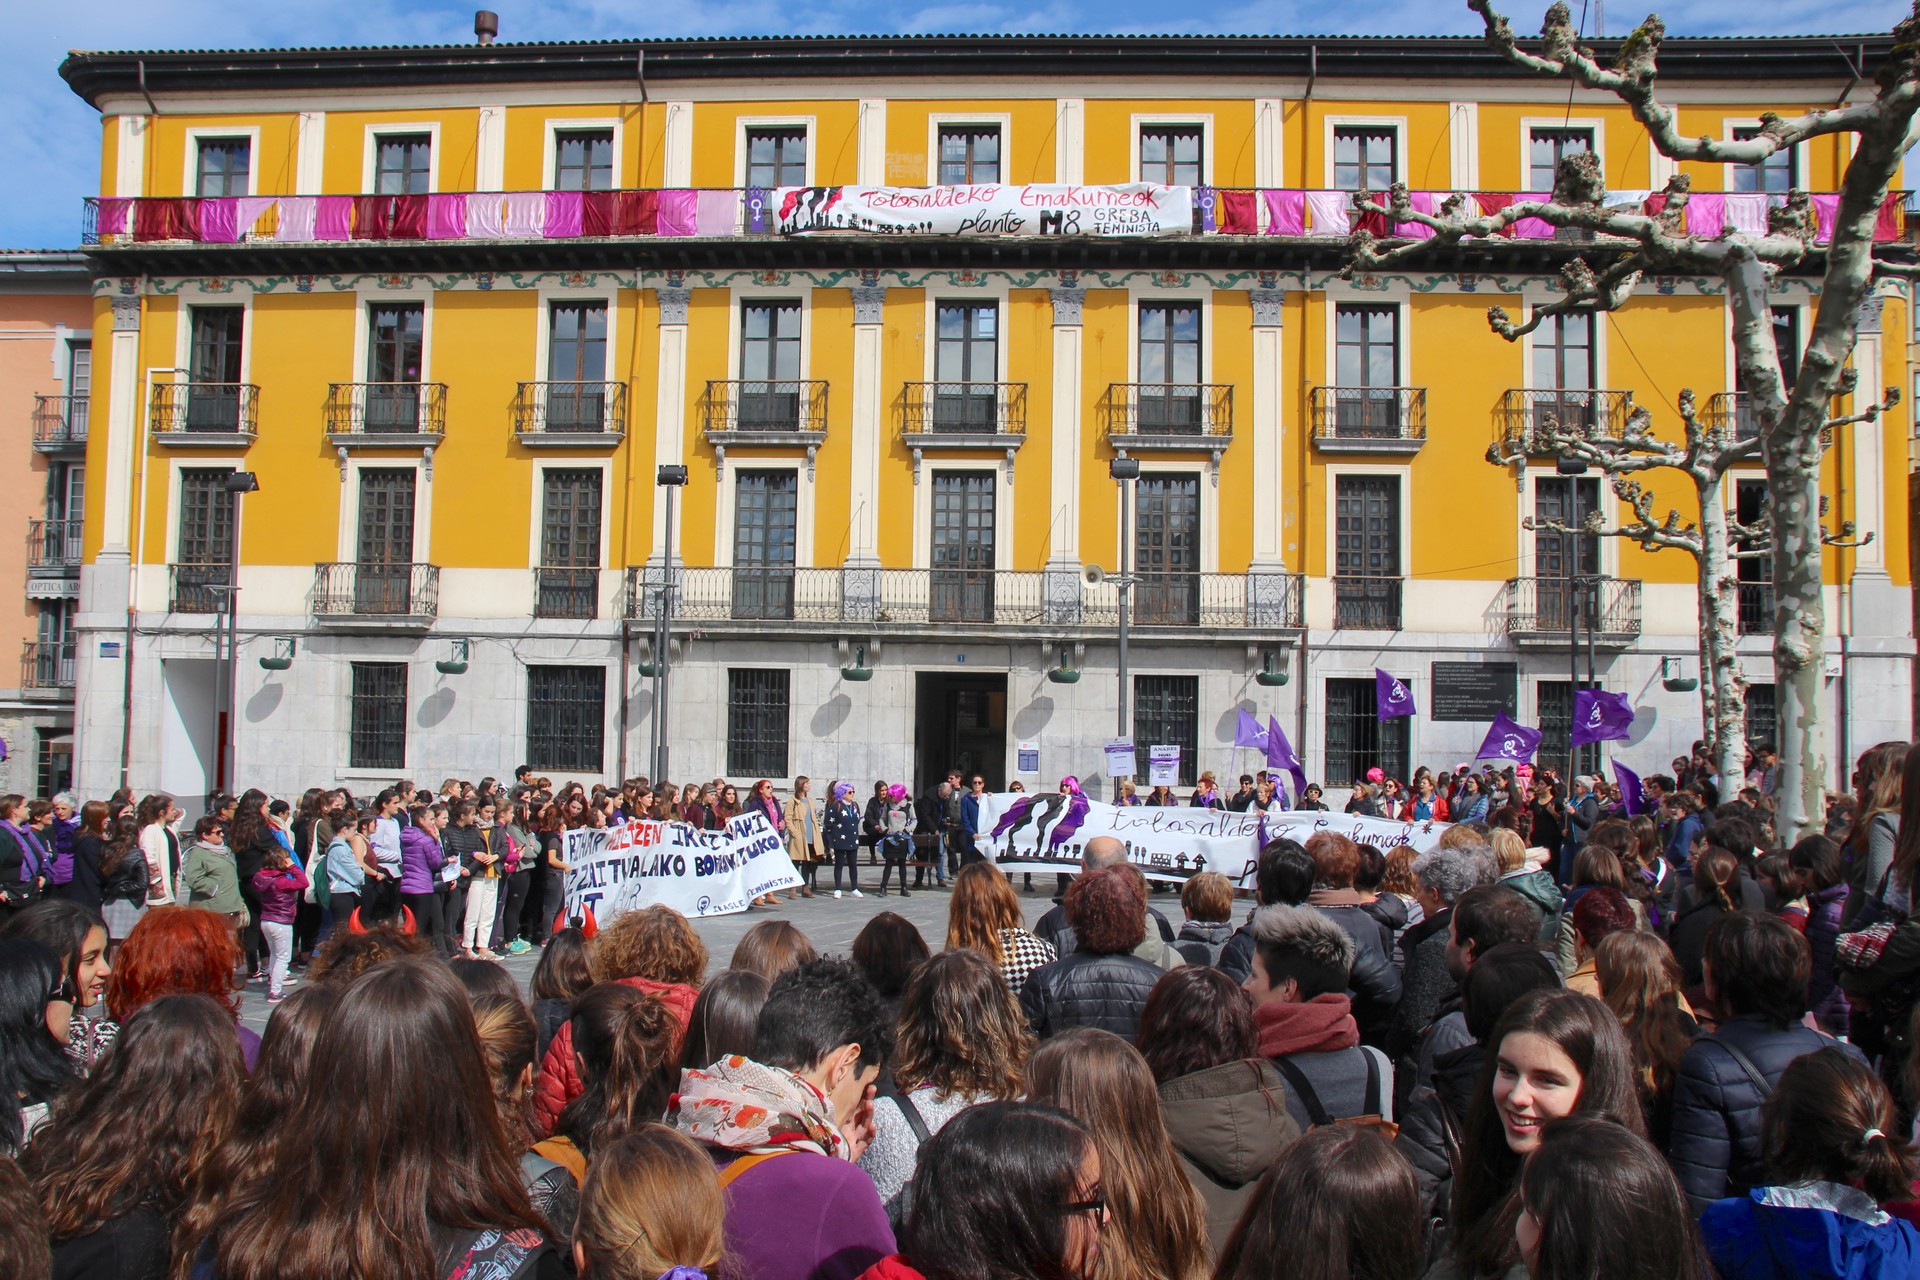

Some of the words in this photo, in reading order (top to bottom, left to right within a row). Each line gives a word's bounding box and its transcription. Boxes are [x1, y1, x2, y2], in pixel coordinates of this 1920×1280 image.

[956, 208, 1026, 236] planto
[1040, 209, 1081, 235] M8
[1094, 207, 1151, 224] GREBA
[1094, 221, 1161, 235] FEMINISTA
[31, 582, 62, 592] OPTICA
[569, 831, 607, 863] BIHAR
